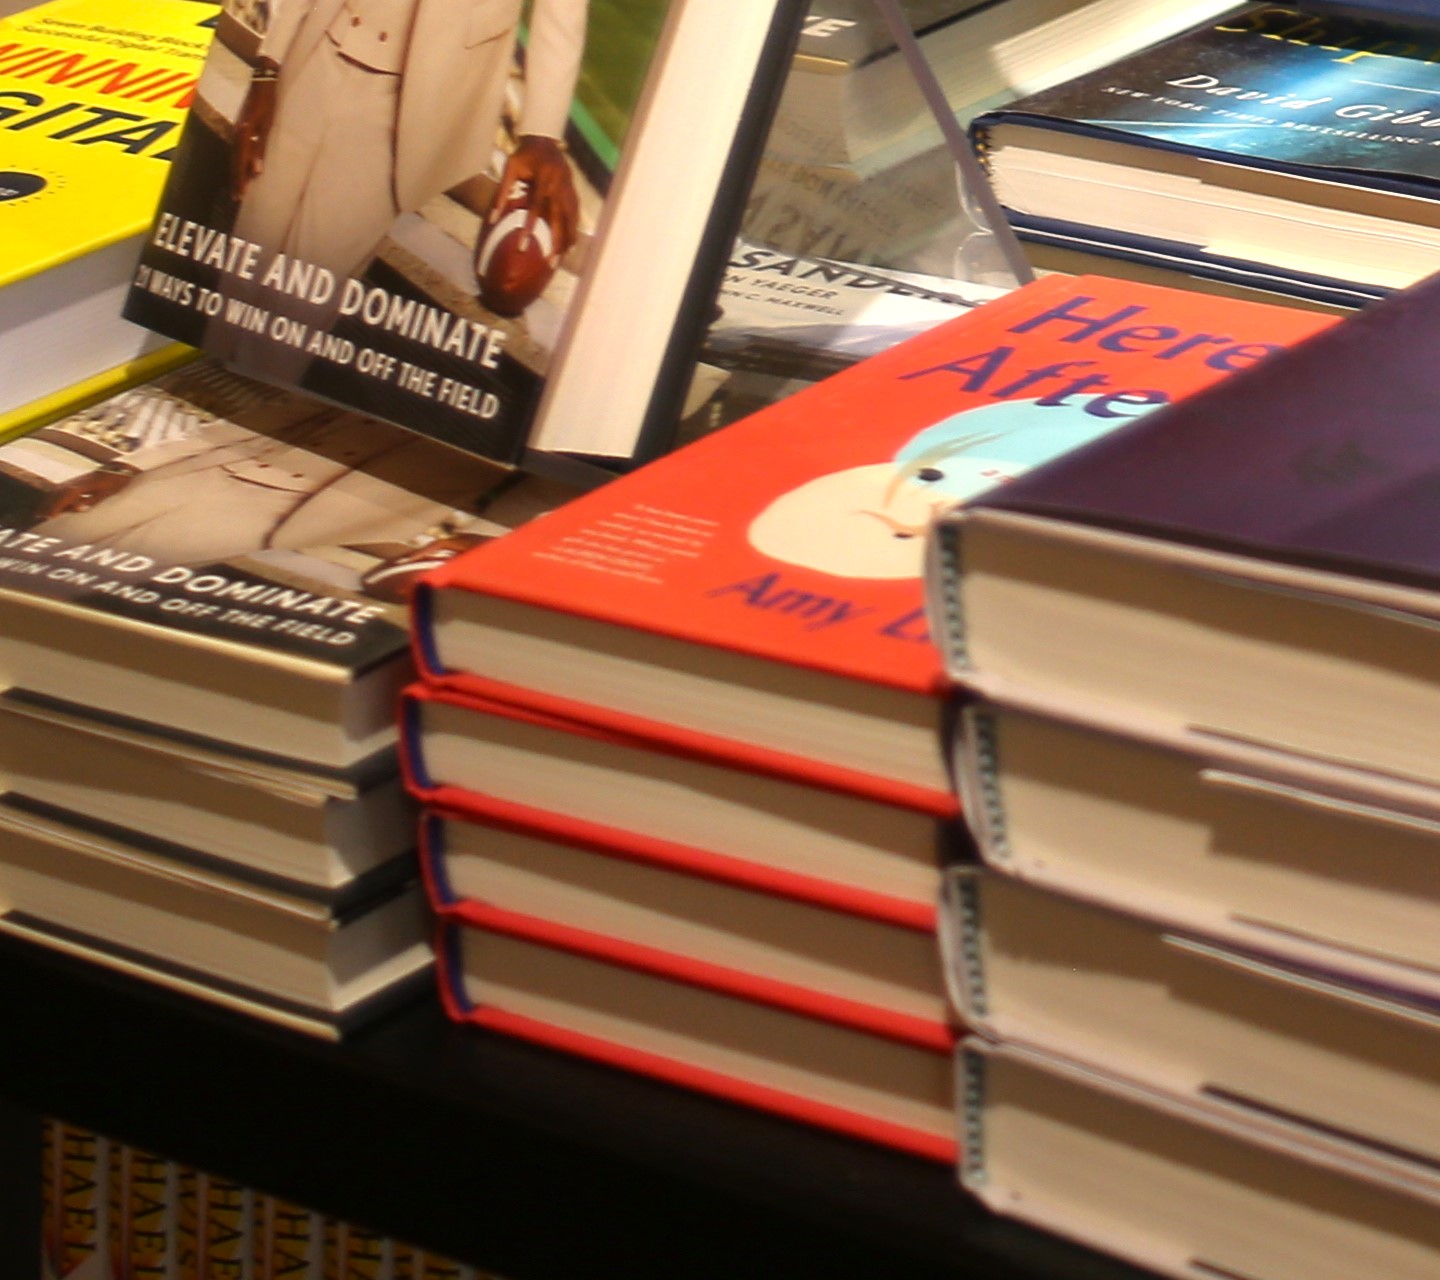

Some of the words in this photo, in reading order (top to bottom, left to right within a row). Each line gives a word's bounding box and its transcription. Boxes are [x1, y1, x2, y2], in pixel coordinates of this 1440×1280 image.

[1100, 85, 1152, 99] NEW
[1151, 95, 1205, 112] YORK
[1213, 108, 1277, 126] TIMES
[1279, 120, 1424, 146] BESTSELLING
[1164, 73, 1333, 112] David
[153, 213, 262, 280] ELEVATE
[263, 253, 335, 306] AND
[339, 277, 507, 370] DOMINATE
[750, 276, 840, 301] YAEGER
[764, 296, 847, 316] MAXWELL
[147, 272, 195, 306] WAYS
[195, 287, 222, 317] TO
[225, 298, 267, 334] WIN
[271, 316, 308, 348] ON
[306, 329, 353, 366] AND
[357, 348, 397, 382] OFF
[398, 362, 438, 399] THE
[437, 377, 500, 422] FIELD
[1006, 295, 1282, 373] Here
[47, 568, 98, 586] ON
[92, 580, 160, 605] AND
[159, 597, 220, 618] OFF
[217, 608, 275, 629] THE
[270, 619, 357, 646] FIELD
[53, 543, 155, 573] AND
[152, 566, 386, 625] DOMINATE
[709, 570, 881, 633] Amy
